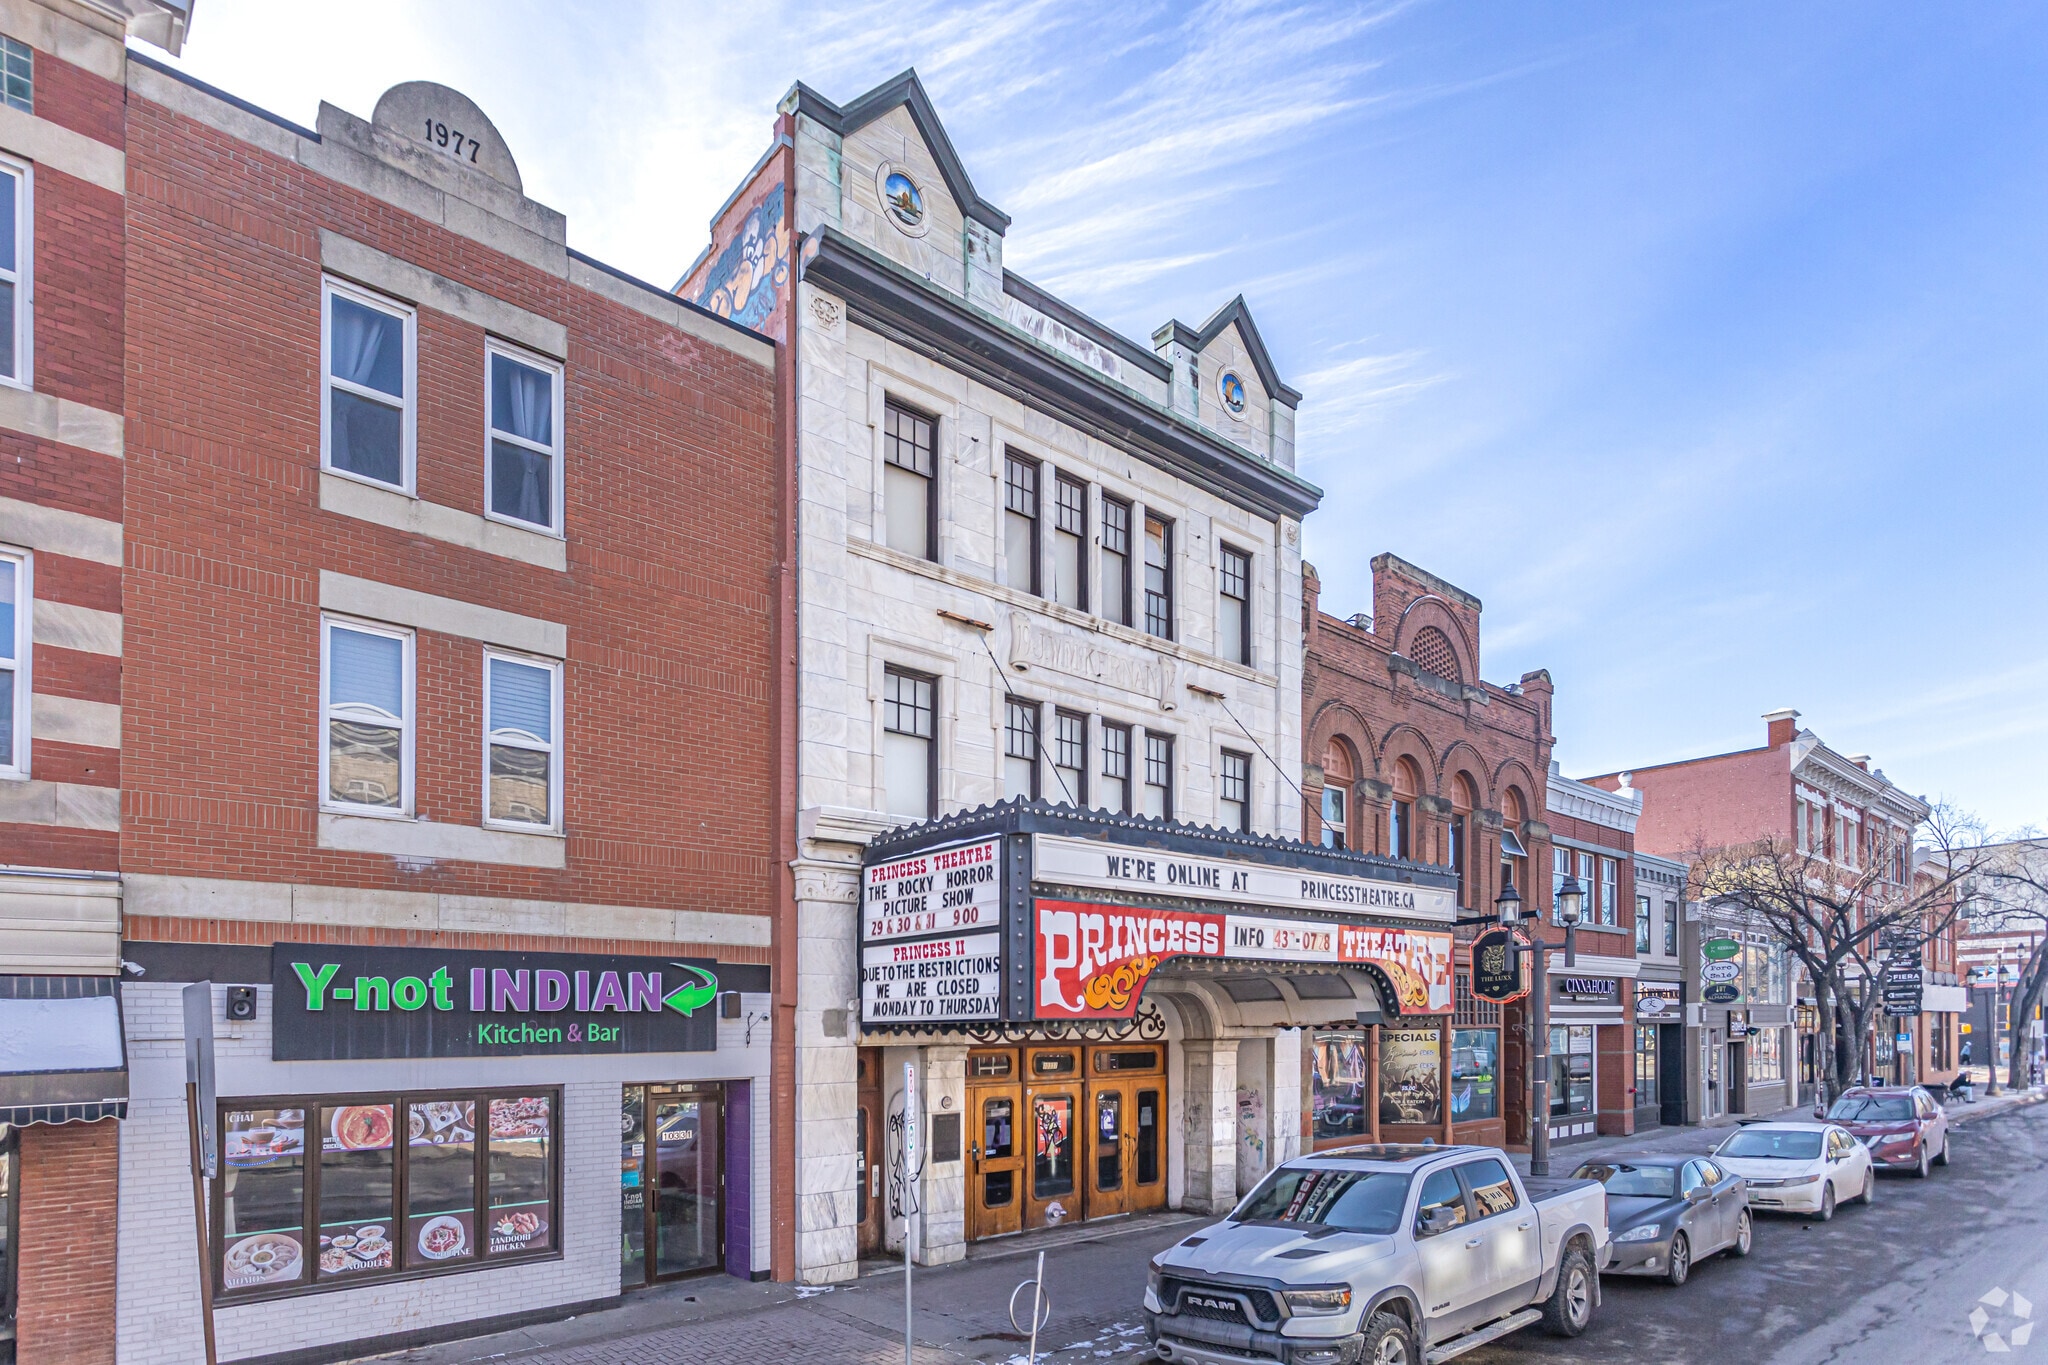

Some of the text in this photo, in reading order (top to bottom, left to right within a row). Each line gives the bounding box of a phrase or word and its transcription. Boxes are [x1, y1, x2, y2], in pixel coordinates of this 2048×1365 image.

[425, 118, 480, 164] 1977
[872, 844, 992, 883] PRINCESS THEATRE
[868, 864, 993, 901] THE ROCKY HORROR
[1106, 854, 1415, 911] WE'RE ONLINE AT PRINCESSTHEATRE.CA
[884, 887, 974, 917] PICTURE SHOW
[871, 921, 883, 936] 29
[886, 919, 893, 934] &
[897, 917, 911, 933] 30
[914, 916, 922, 931] &
[926, 912, 936, 929] 31
[1234, 926, 1264, 948] INFO
[893, 940, 965, 962] PRINCESS II
[1040, 910, 1220, 1013] PRINCESS
[863, 956, 1000, 983] DUE TO THE RESTRICTIONS
[1343, 930, 1450, 1010] THEATRE
[291, 962, 663, 1012] Y-not INDIAN
[876, 978, 979, 999] WE ARE CLOSED
[1566, 978, 1615, 994] CINNAHOLIC
[873, 996, 1000, 1017] MONDAY TO THURSDAY
[477, 1023, 620, 1044] Kitchen & Bar
[1380, 1033, 1437, 1042] SPECIALS
[229, 1114, 254, 1123] CHAI
[525, 1127, 549, 1136] PIZZA
[490, 1233, 531, 1245] TANDOORI
[490, 1242, 526, 1252] CHICKEN
[347, 1259, 390, 1271] NOODLES
[1187, 1296, 1236, 1310] RAM
[1432, 1302, 1450, 1312] RAM
